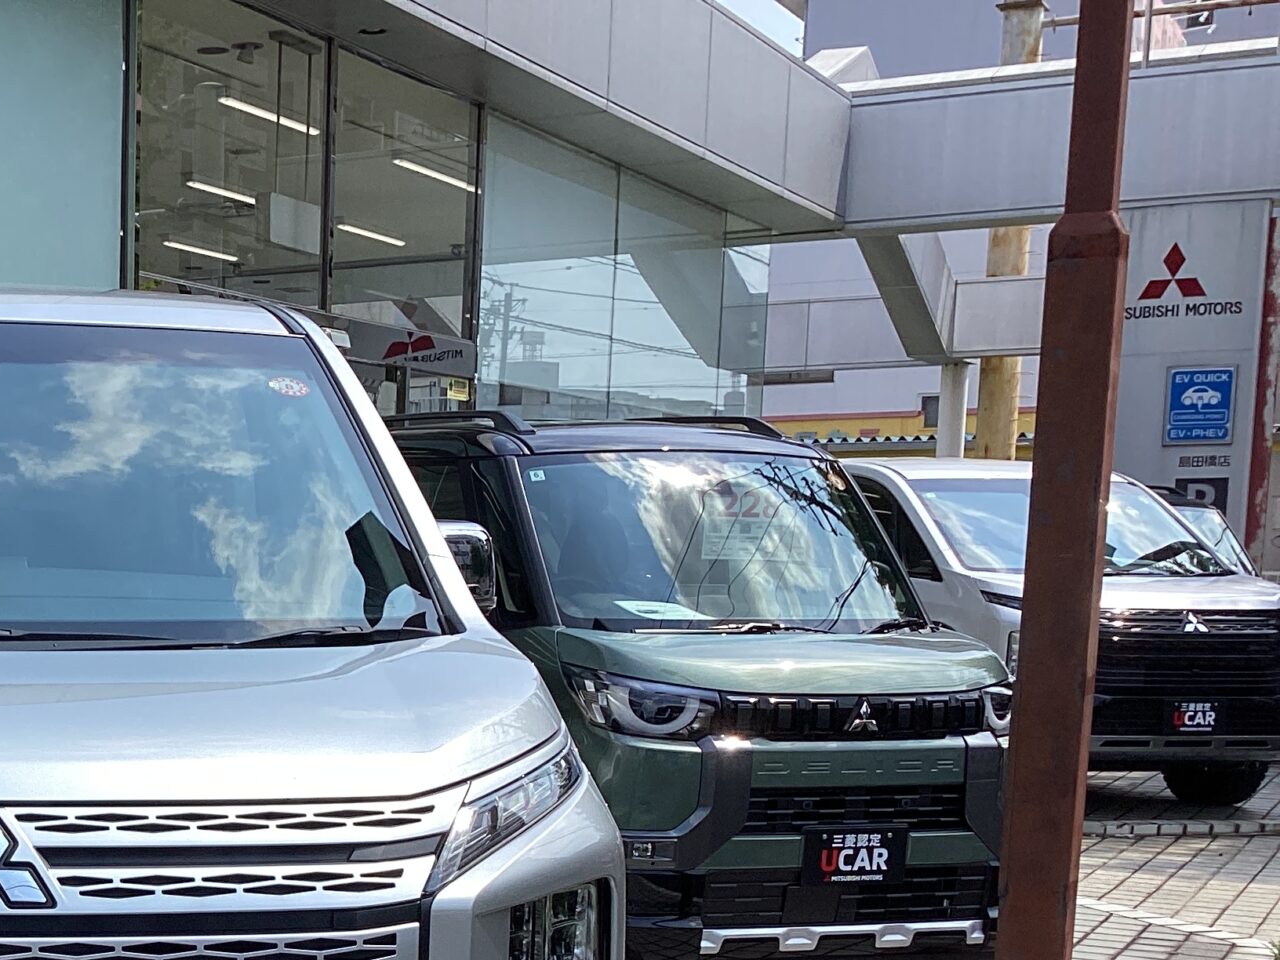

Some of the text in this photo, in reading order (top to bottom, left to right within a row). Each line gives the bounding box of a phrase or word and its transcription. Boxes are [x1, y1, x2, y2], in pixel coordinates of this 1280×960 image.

[1124, 301, 1243, 320] SUBISHI MOTORS
[1175, 372, 1230, 383] EV QUICK
[1173, 711, 1216, 726] UCAR
[831, 833, 882, 847] 三菱認定
[819, 847, 889, 872] UCAR
